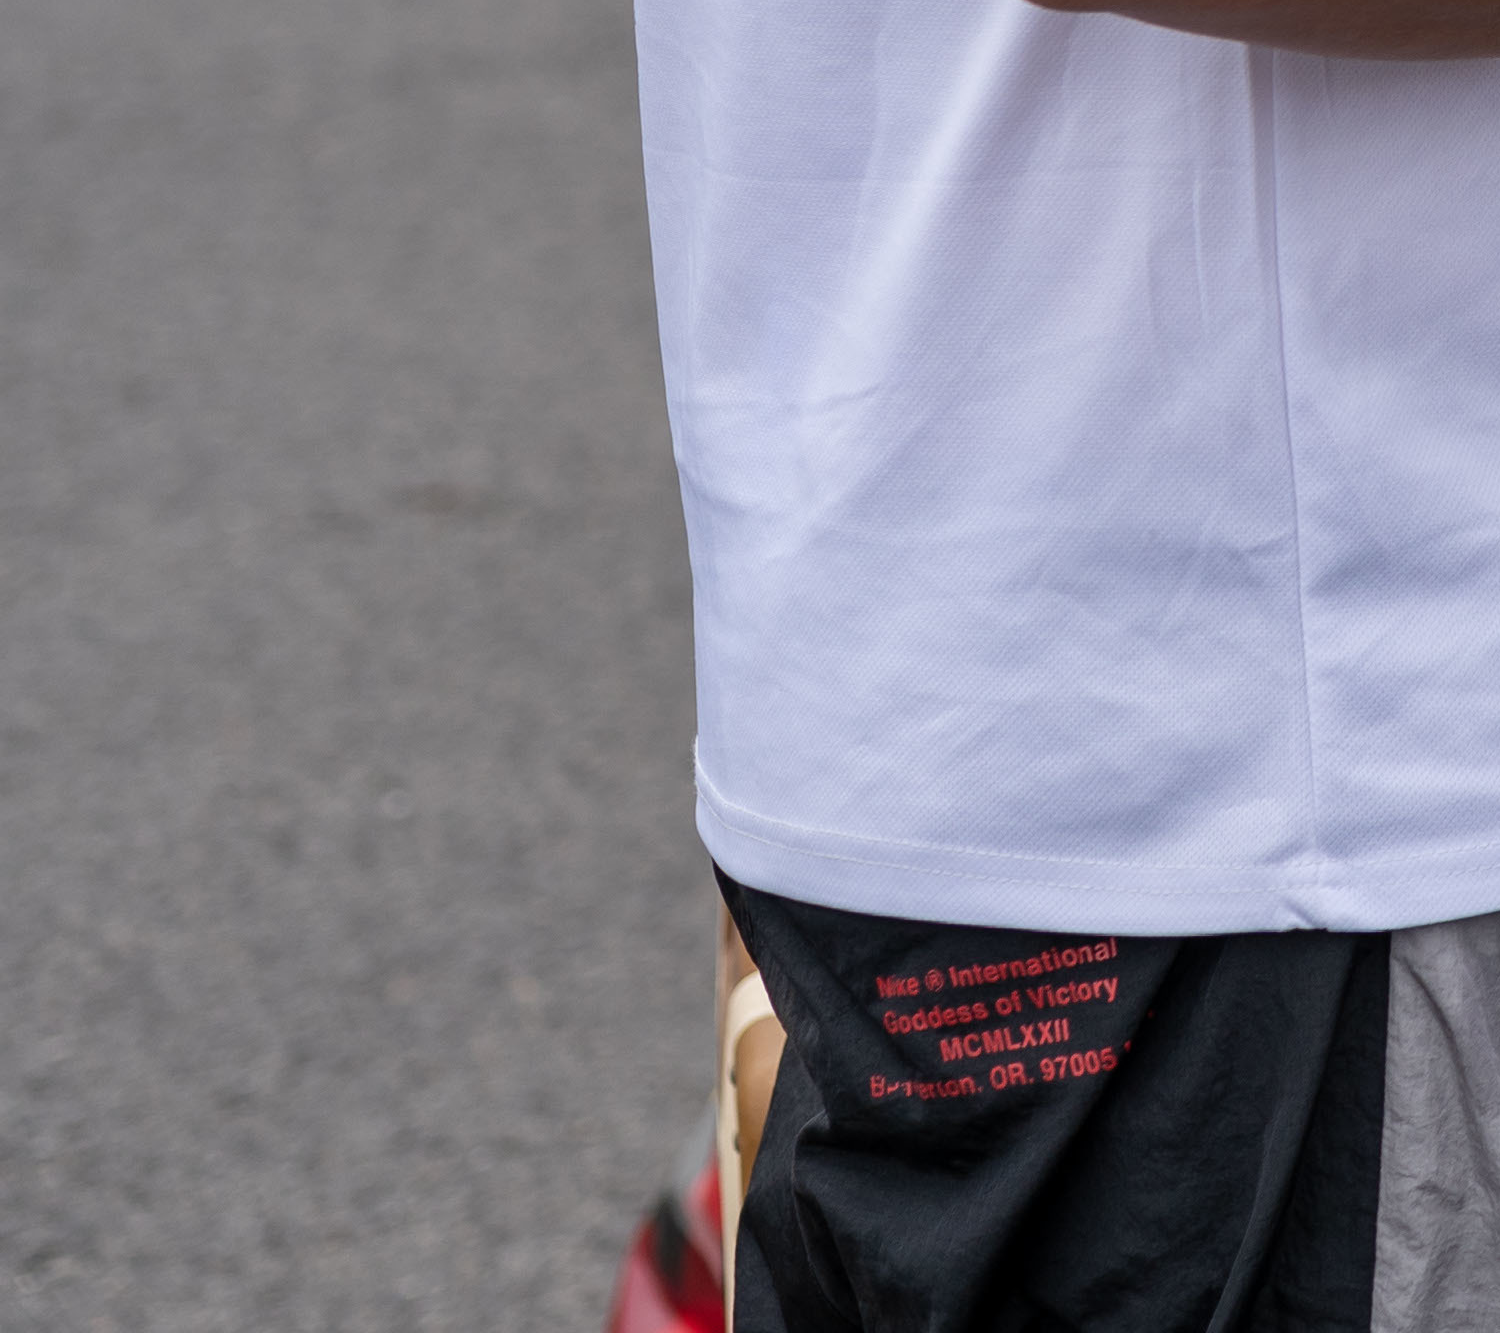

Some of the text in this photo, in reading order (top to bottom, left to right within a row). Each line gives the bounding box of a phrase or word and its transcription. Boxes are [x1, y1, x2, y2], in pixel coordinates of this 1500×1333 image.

[949, 937, 1117, 987] International
[883, 977, 1118, 1034] Goddess of Victory
[938, 1018, 1071, 1062] MCMLXXII
[989, 1062, 1034, 1091] OR.
[1039, 1046, 1118, 1082] 97005
